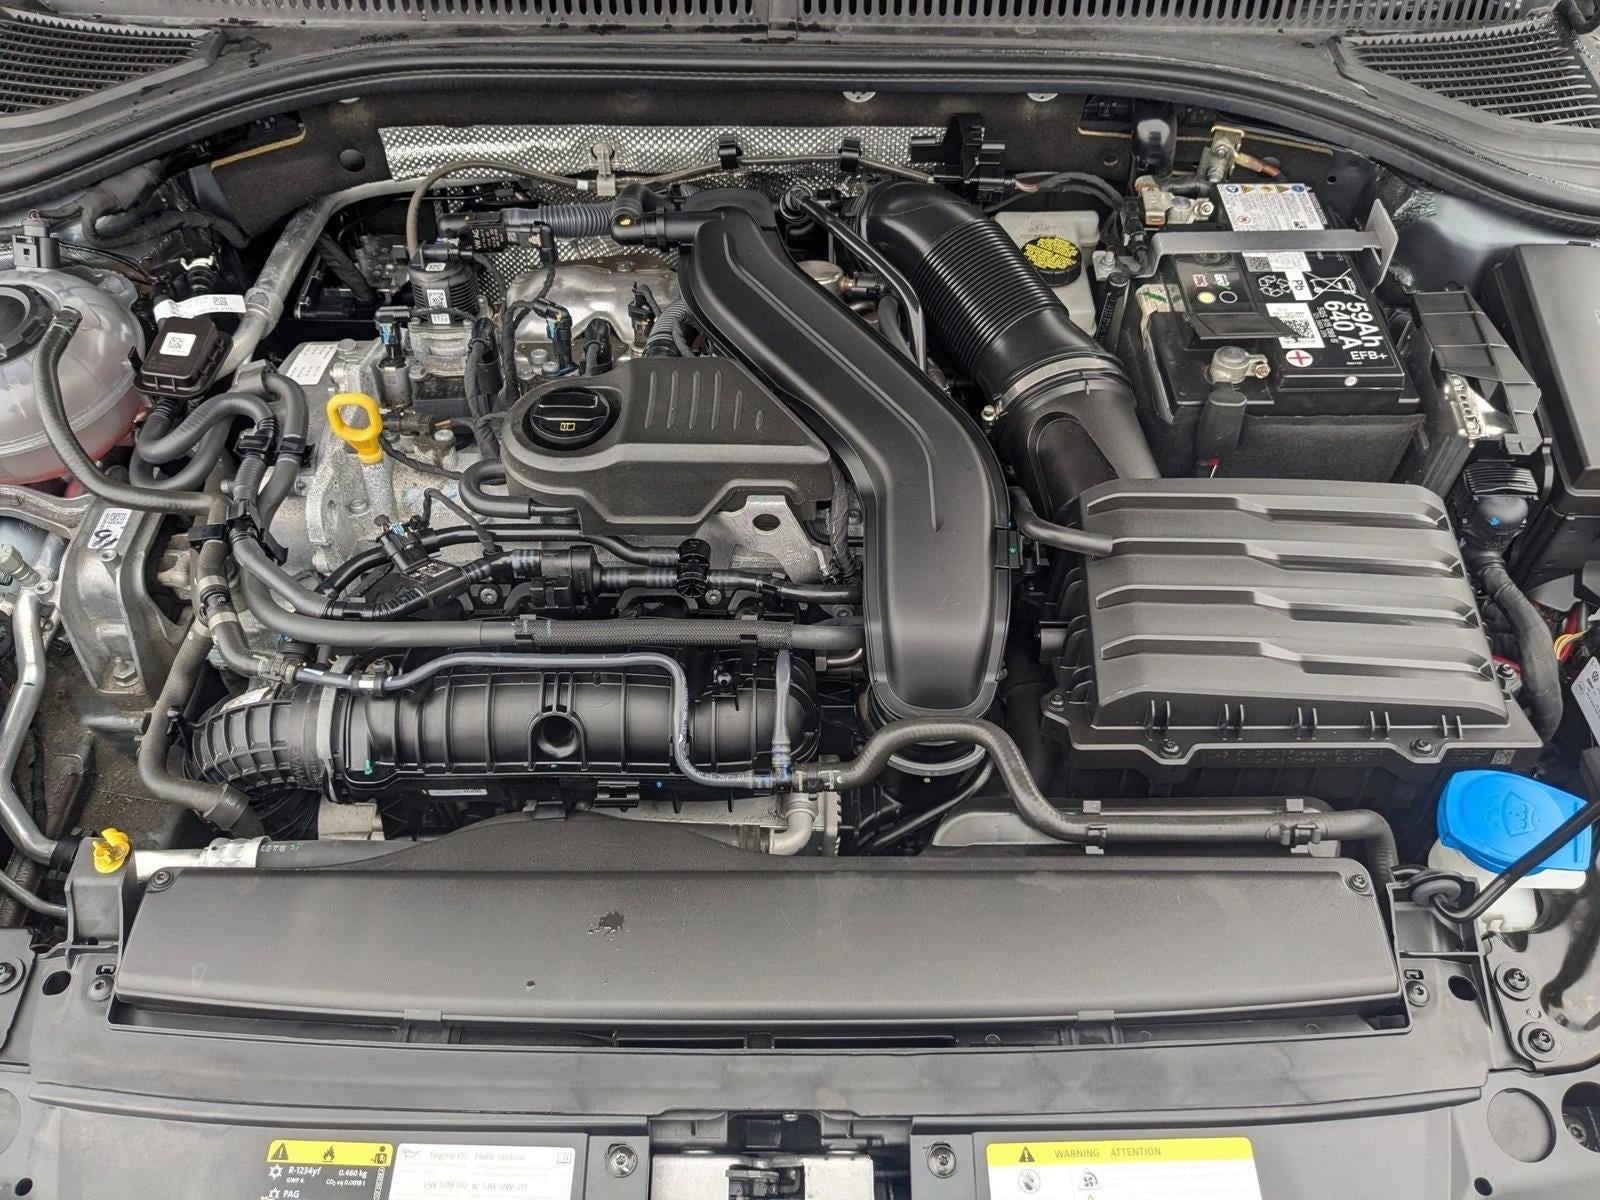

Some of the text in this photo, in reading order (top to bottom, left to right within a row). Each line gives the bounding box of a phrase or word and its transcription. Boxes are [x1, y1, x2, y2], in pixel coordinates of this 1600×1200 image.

[472, 229, 480, 239] AG
[1324, 301, 1355, 331] 640
[1346, 301, 1383, 347] 59Ah
[1338, 335, 1363, 350] A
[1350, 350, 1388, 360] EFB+
[429, 1151, 455, 1161] Engine
[1054, 1147, 1161, 1158] WARNING ATTENTION
[288, 1166, 321, 1177] R-1234yf
[358, 1169, 368, 1179] kg
[423, 1181, 436, 1189] VW
[440, 1181, 454, 1189] 508
[283, 1189, 300, 1199] PAG
